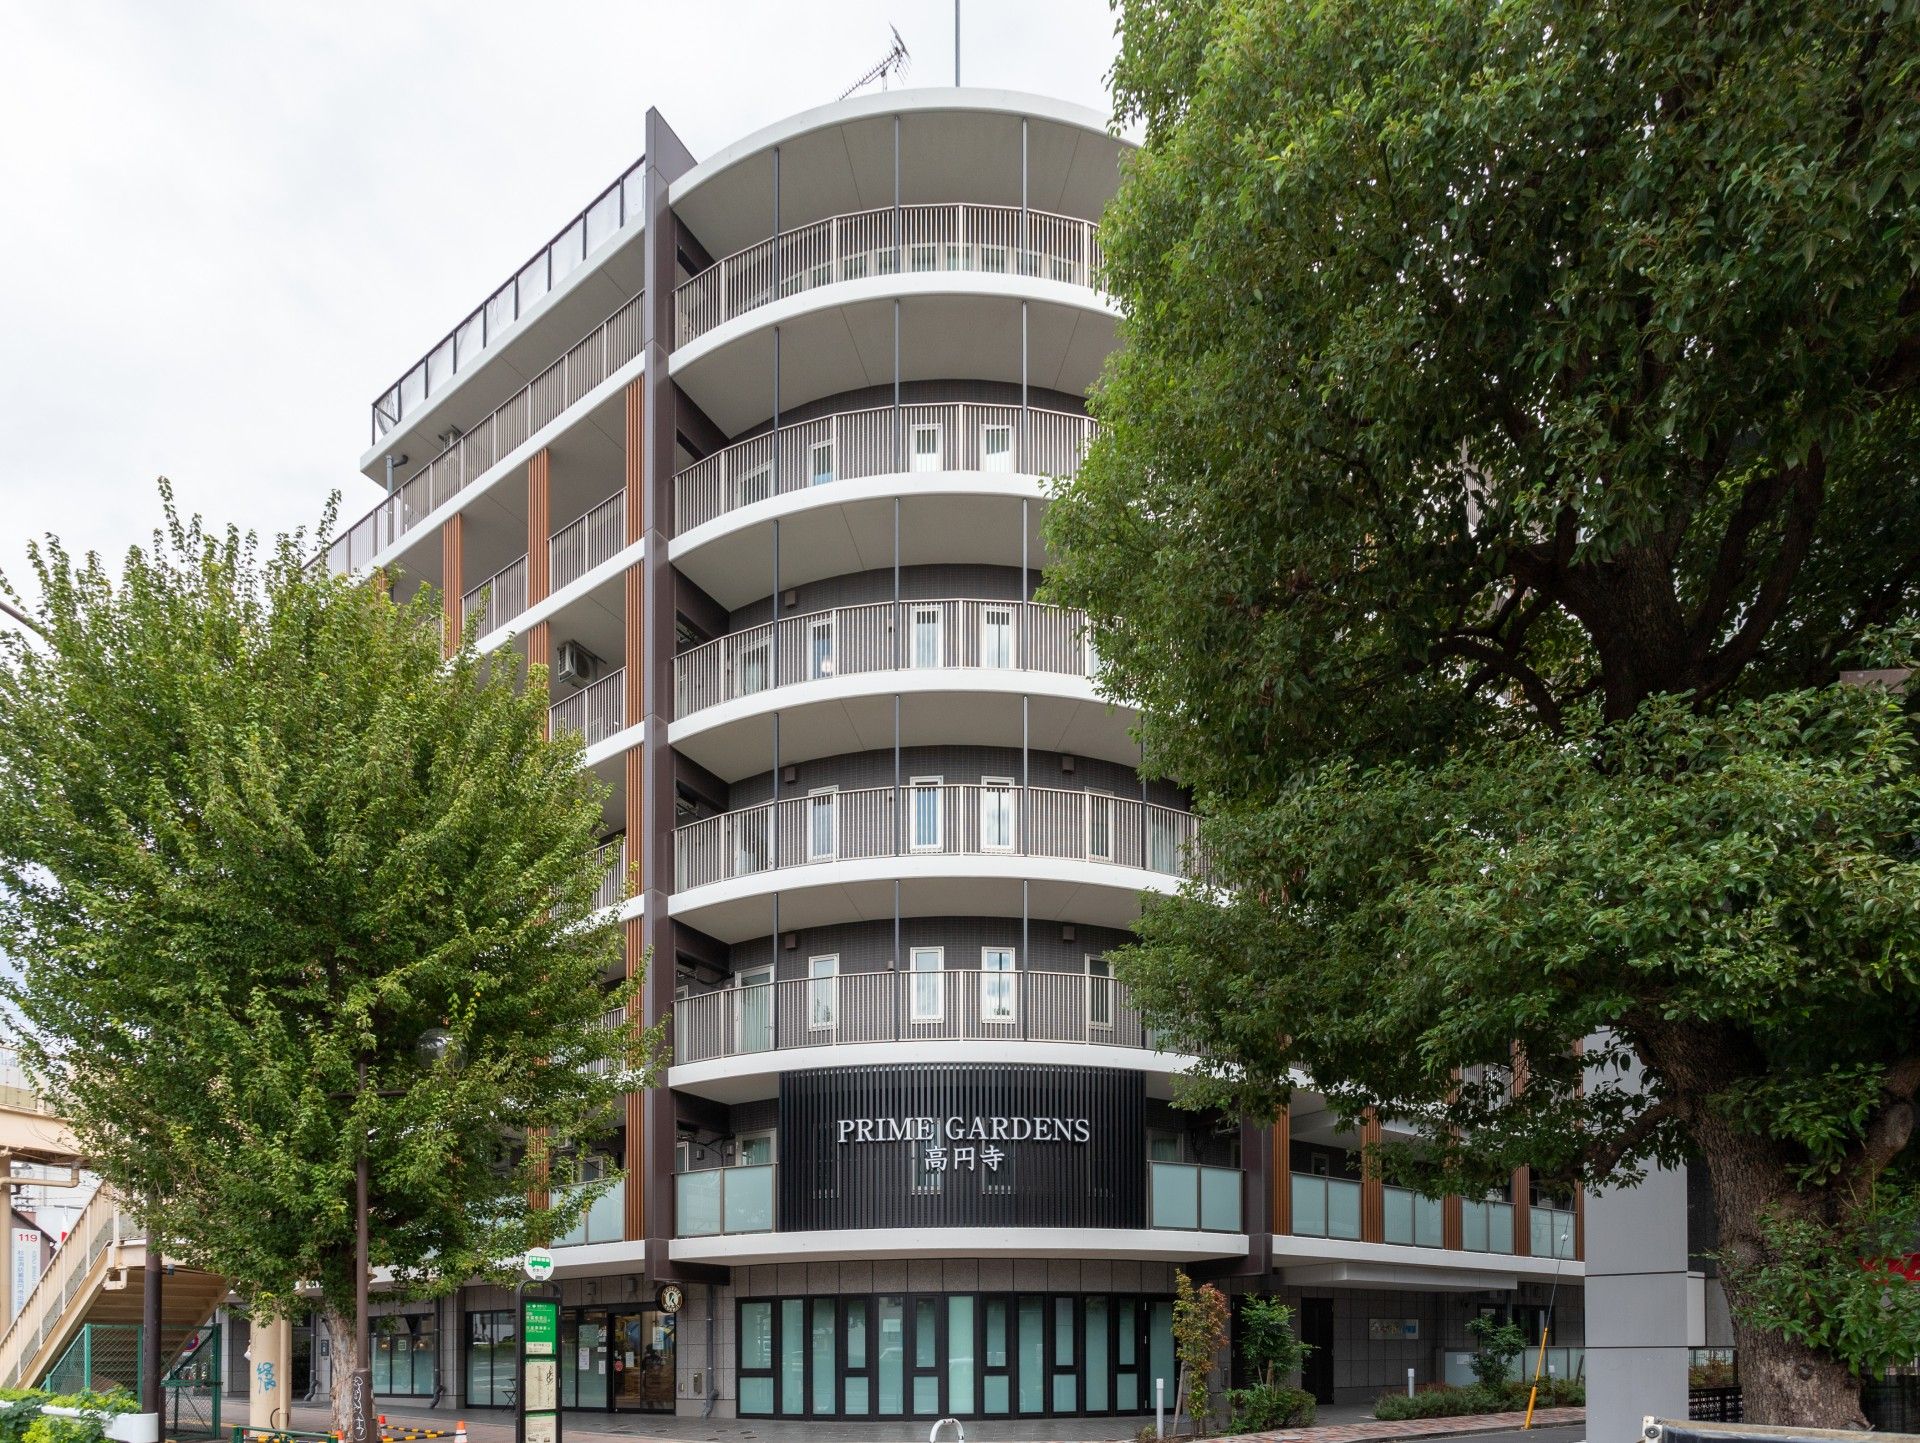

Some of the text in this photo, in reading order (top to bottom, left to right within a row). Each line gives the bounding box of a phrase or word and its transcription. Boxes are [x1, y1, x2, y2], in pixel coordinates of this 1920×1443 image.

[837, 1116, 1090, 1143] PRIME GARDENS
[924, 1145, 1005, 1172] 高円寺
[18, 1233, 38, 1242] 119
